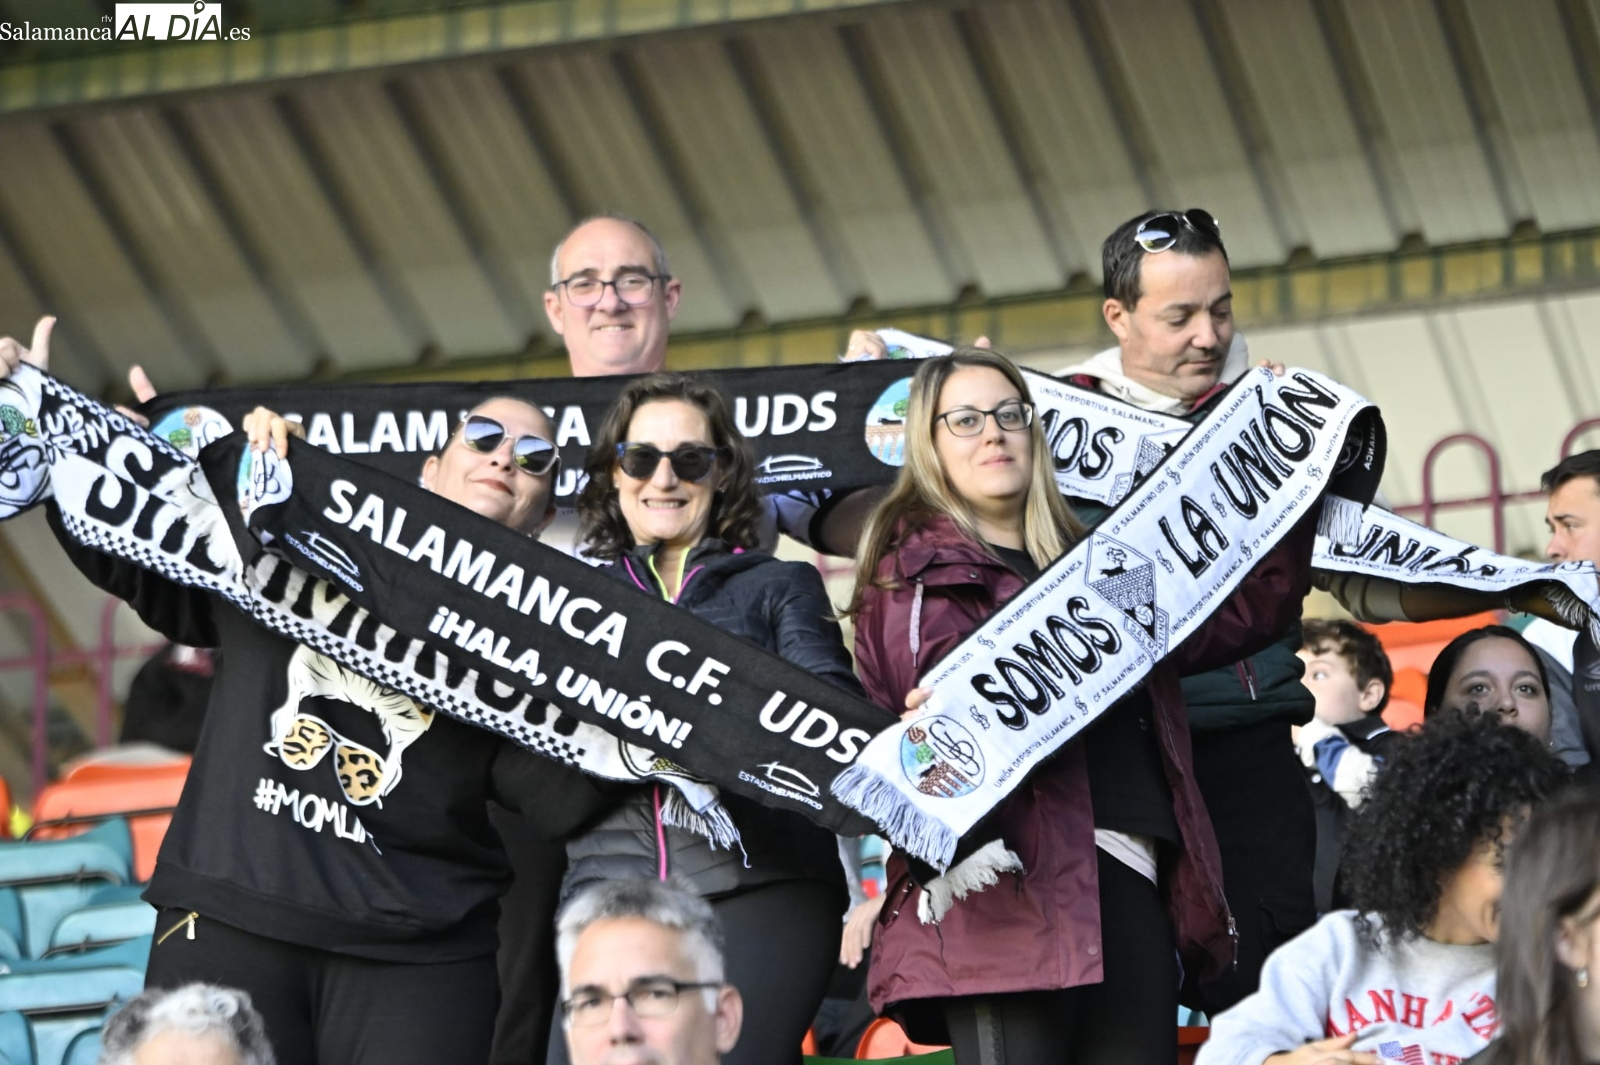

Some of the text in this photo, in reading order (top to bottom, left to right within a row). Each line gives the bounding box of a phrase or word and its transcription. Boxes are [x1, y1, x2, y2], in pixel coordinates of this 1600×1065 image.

[735, 391, 838, 437] UDS
[1065, 394, 1109, 413] DEPORTIVA
[1112, 408, 1166, 429] SALAMANCA
[1193, 423, 1222, 454] DEPORTIVA
[1220, 387, 1254, 423] SALAMANCA
[1158, 372, 1340, 579] LA UNIÓN
[1112, 480, 1168, 535] CF SALMANTINO UDS
[1261, 500, 1298, 540] SALMANTINO
[1296, 484, 1312, 501] UDS
[1012, 591, 1046, 621] DEPORTIVA
[1044, 560, 1083, 594] SALAMANCA
[1187, 591, 1214, 619] DEPORTIVA
[1212, 558, 1244, 592] SALAMANCA
[322, 479, 628, 658] SALAMANCA
[645, 640, 731, 706] C.F.
[758, 690, 871, 764] UDS
[971, 596, 1122, 731] SOMOS
[1093, 653, 1148, 702] CF SALMANTINO UDS
[994, 714, 1076, 788] UNIÓN DEPORTIVA SALAMANCA
